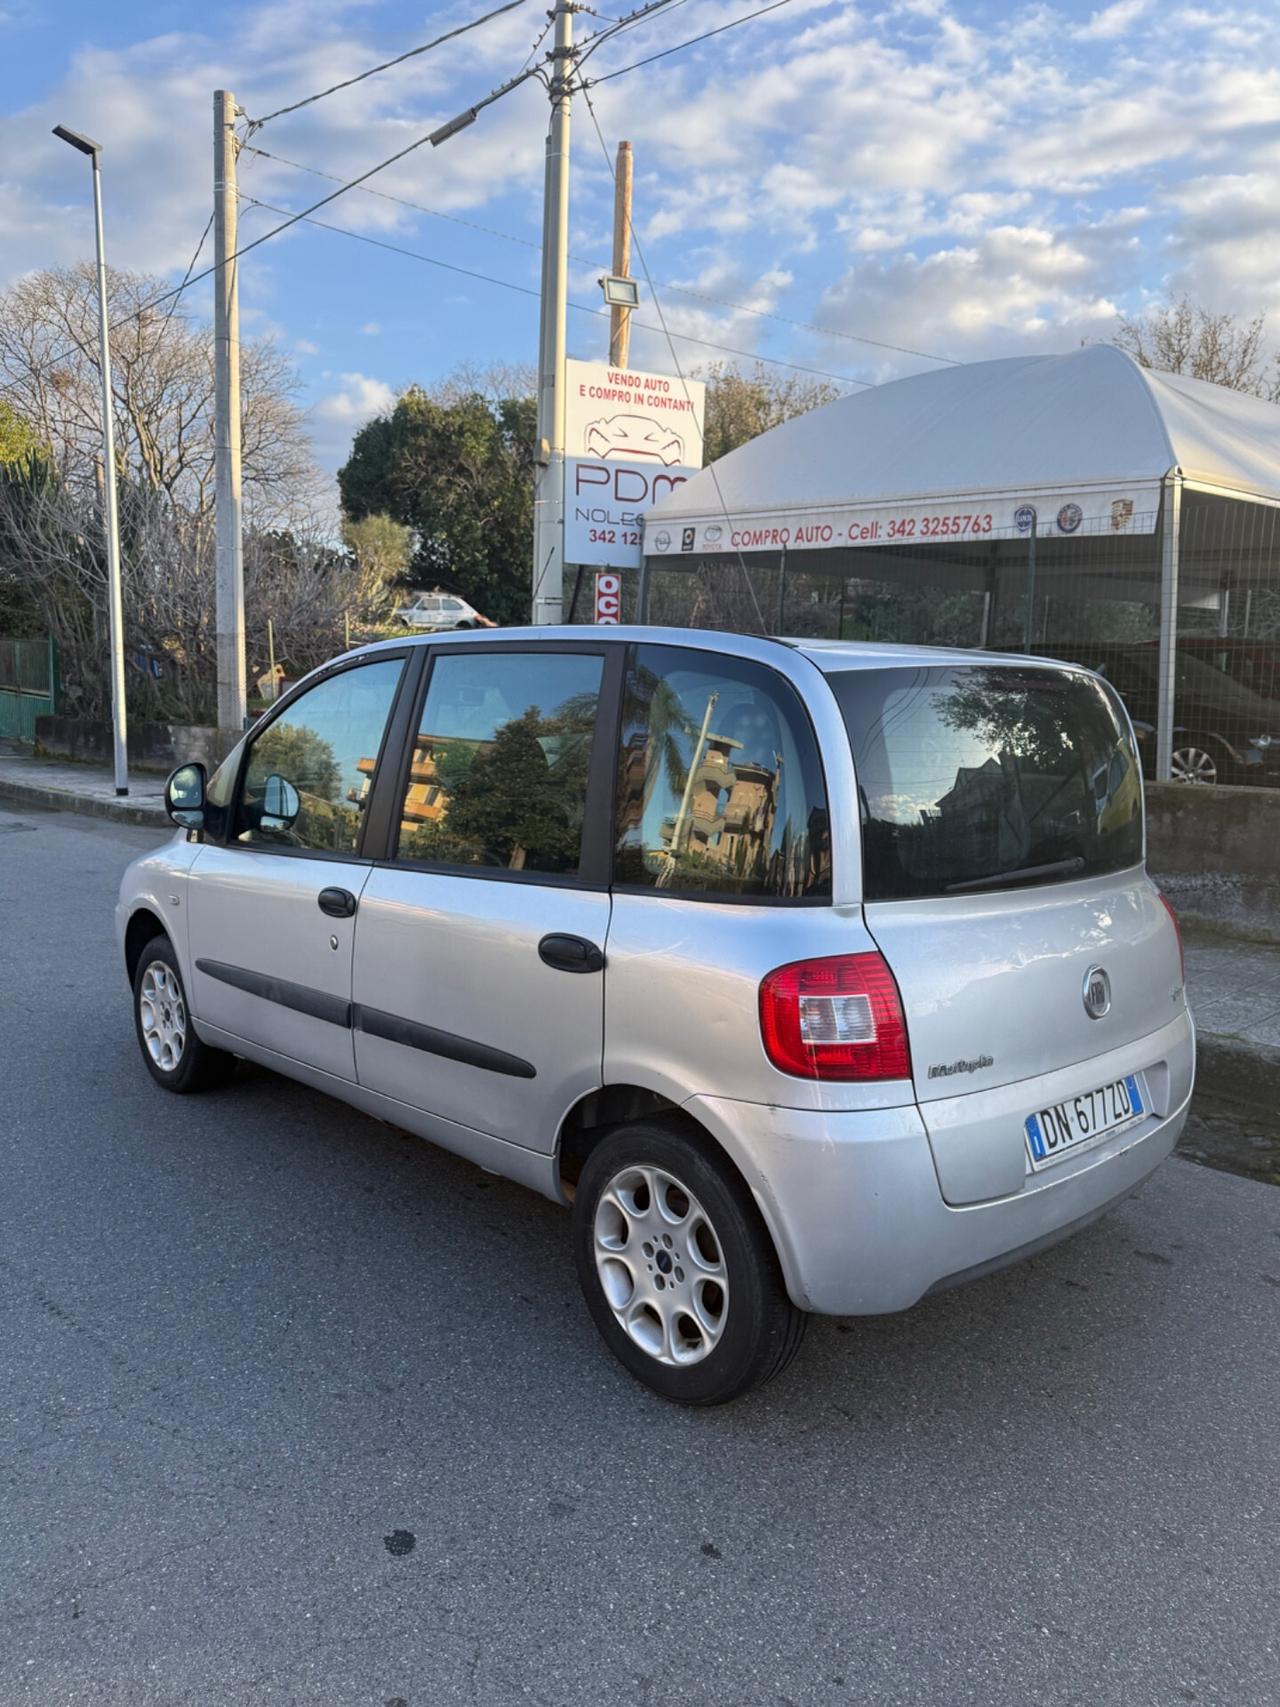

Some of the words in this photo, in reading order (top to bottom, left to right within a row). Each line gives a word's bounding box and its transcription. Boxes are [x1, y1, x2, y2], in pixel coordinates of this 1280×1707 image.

[607, 371, 641, 388] VENDO
[644, 377, 670, 393] AUTO
[579, 384, 586, 397] E
[588, 386, 632, 404] COMPRO
[634, 393, 644, 406] IN
[588, 528, 616, 544] 342
[621, 531, 642, 546] 12
[730, 527, 789, 548] COMPRO
[794, 524, 833, 544] AUTO
[848, 521, 883, 541] Cell:
[887, 518, 916, 538] 342
[919, 513, 993, 536] 3255763
[1039, 1102, 1073, 1150] DN
[1074, 1078, 1131, 1134] 677ZD
